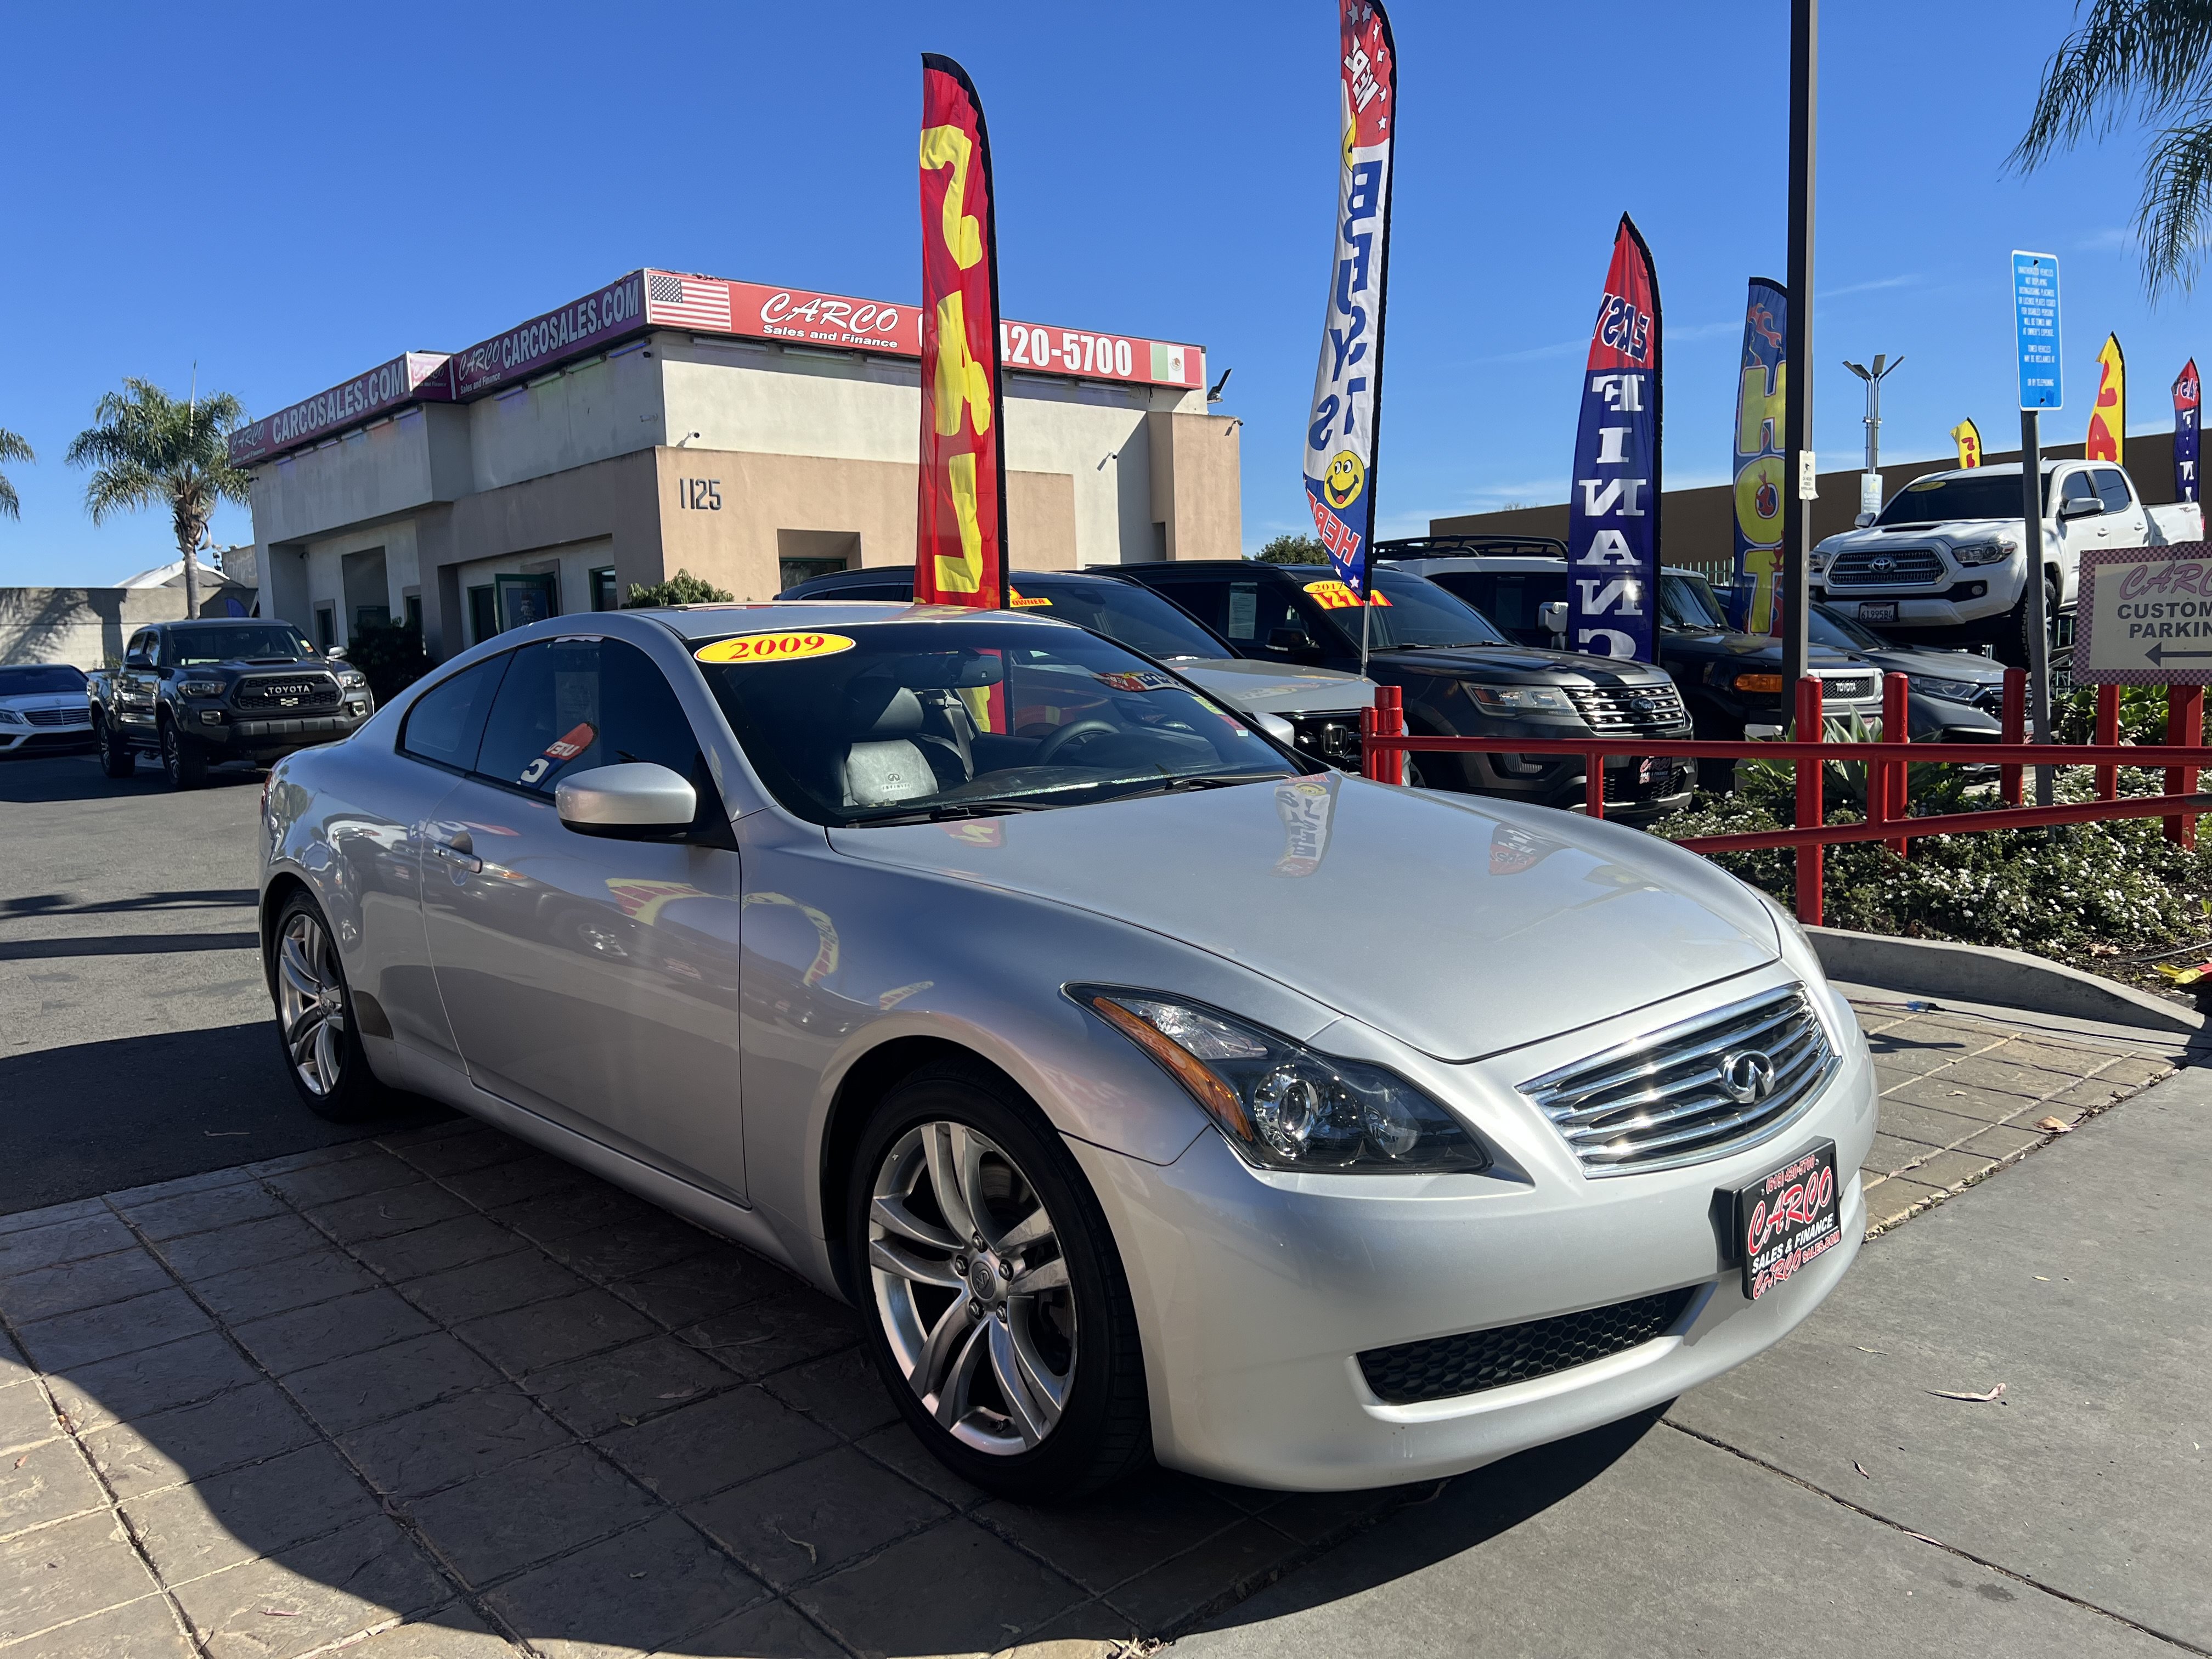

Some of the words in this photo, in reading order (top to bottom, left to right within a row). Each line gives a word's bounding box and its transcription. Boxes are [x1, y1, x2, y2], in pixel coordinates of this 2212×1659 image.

[502, 279, 639, 369] CARCOSALES.COM
[760, 292, 899, 333] CARCO
[763, 325, 805, 338] Sales
[810, 329, 837, 341] and
[842, 333, 898, 348] Finance
[458, 340, 500, 381] CARCO
[273, 360, 404, 444] CARCOSALES.COM
[680, 478, 722, 510] 1125
[1736, 359, 1786, 636] HOT
[1313, 583, 1342, 592] 2017
[1313, 590, 1386, 610] 1277
[727, 635, 825, 660] 2009
[268, 685, 310, 695] TOYOTA
[1836, 682, 1857, 692] TOYOTA
[1766, 1171, 1784, 1195] (619)
[1785, 1154, 1816, 1183] 420-5700
[1747, 1165, 1833, 1256] CARCO
[1752, 1243, 1784, 1274] SALES
[1785, 1238, 1793, 1255] &
[1795, 1212, 1834, 1248] FINANCE
